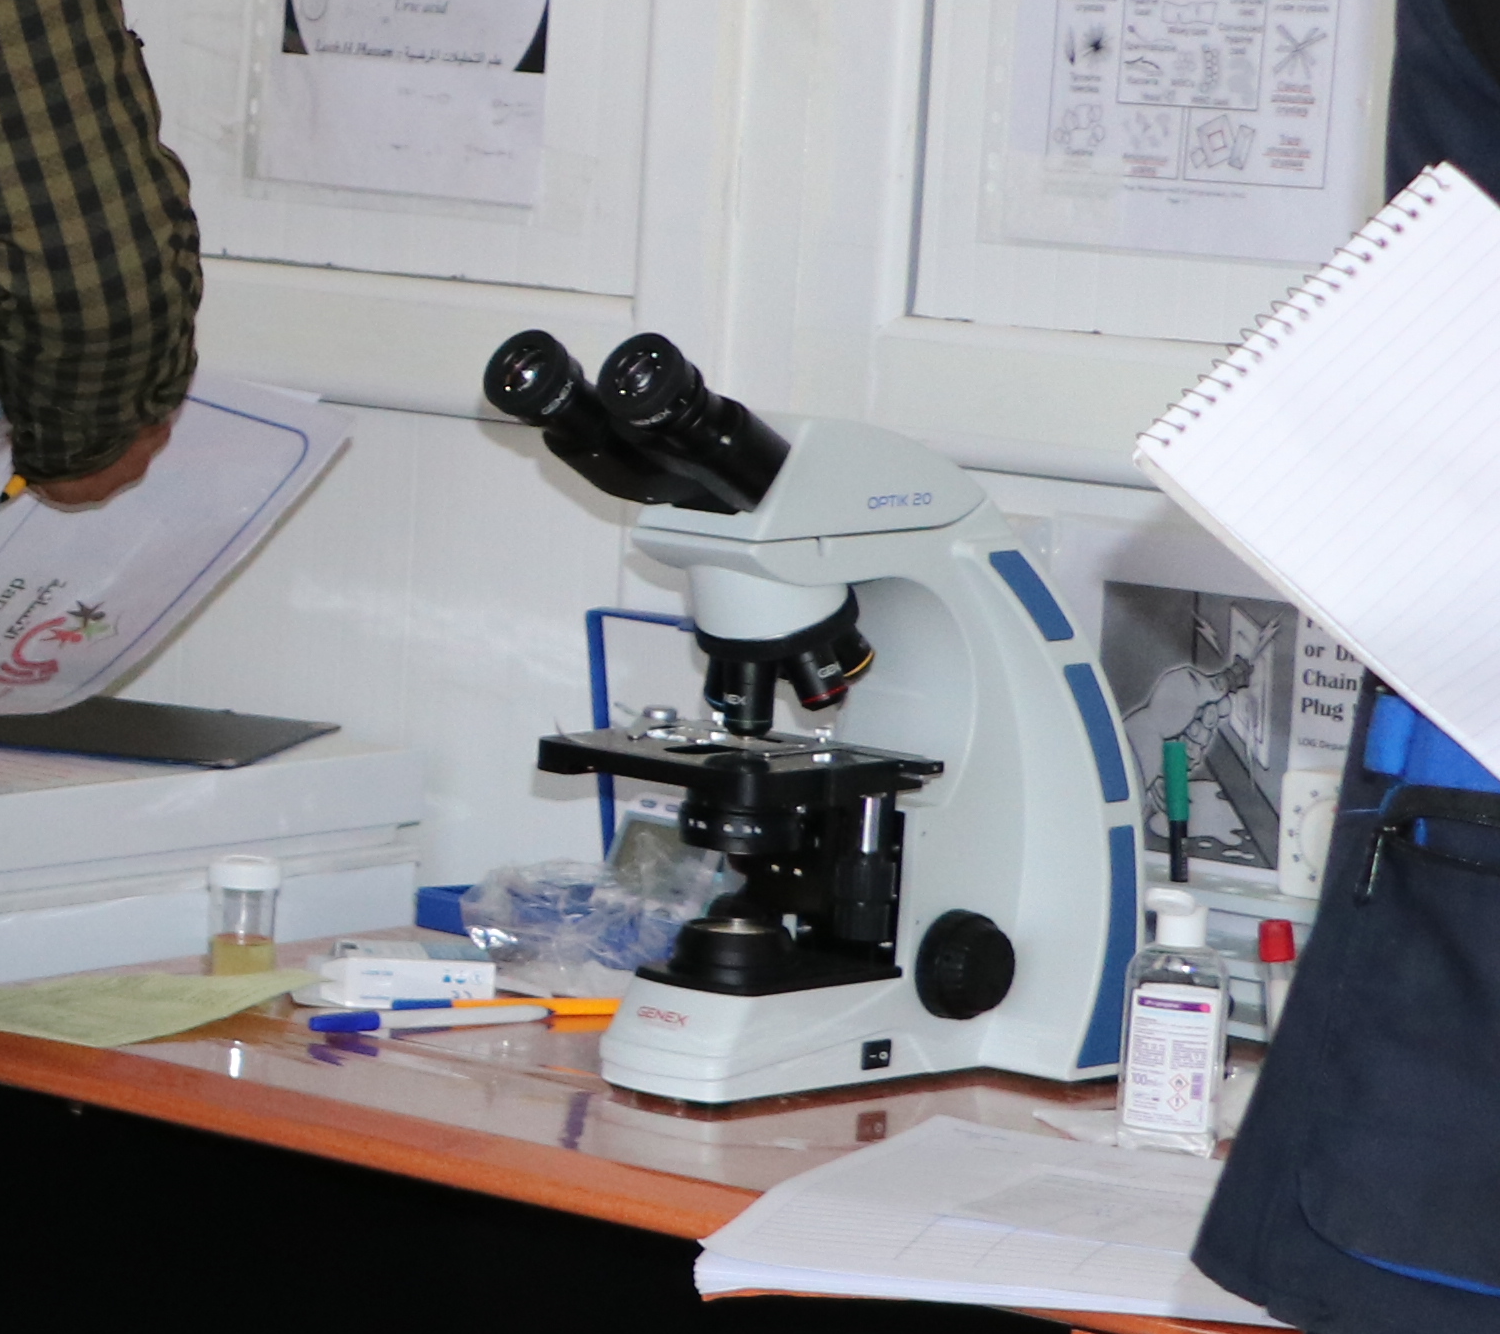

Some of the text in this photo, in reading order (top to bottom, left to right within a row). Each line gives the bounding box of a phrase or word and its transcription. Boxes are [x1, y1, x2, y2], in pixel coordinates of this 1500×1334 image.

[867, 492, 932, 510] OPTIK 20
[1304, 644, 1325, 658] or
[1302, 668, 1357, 691] Chain
[1301, 696, 1344, 723] Plug
[636, 1005, 689, 1027] GENEX
